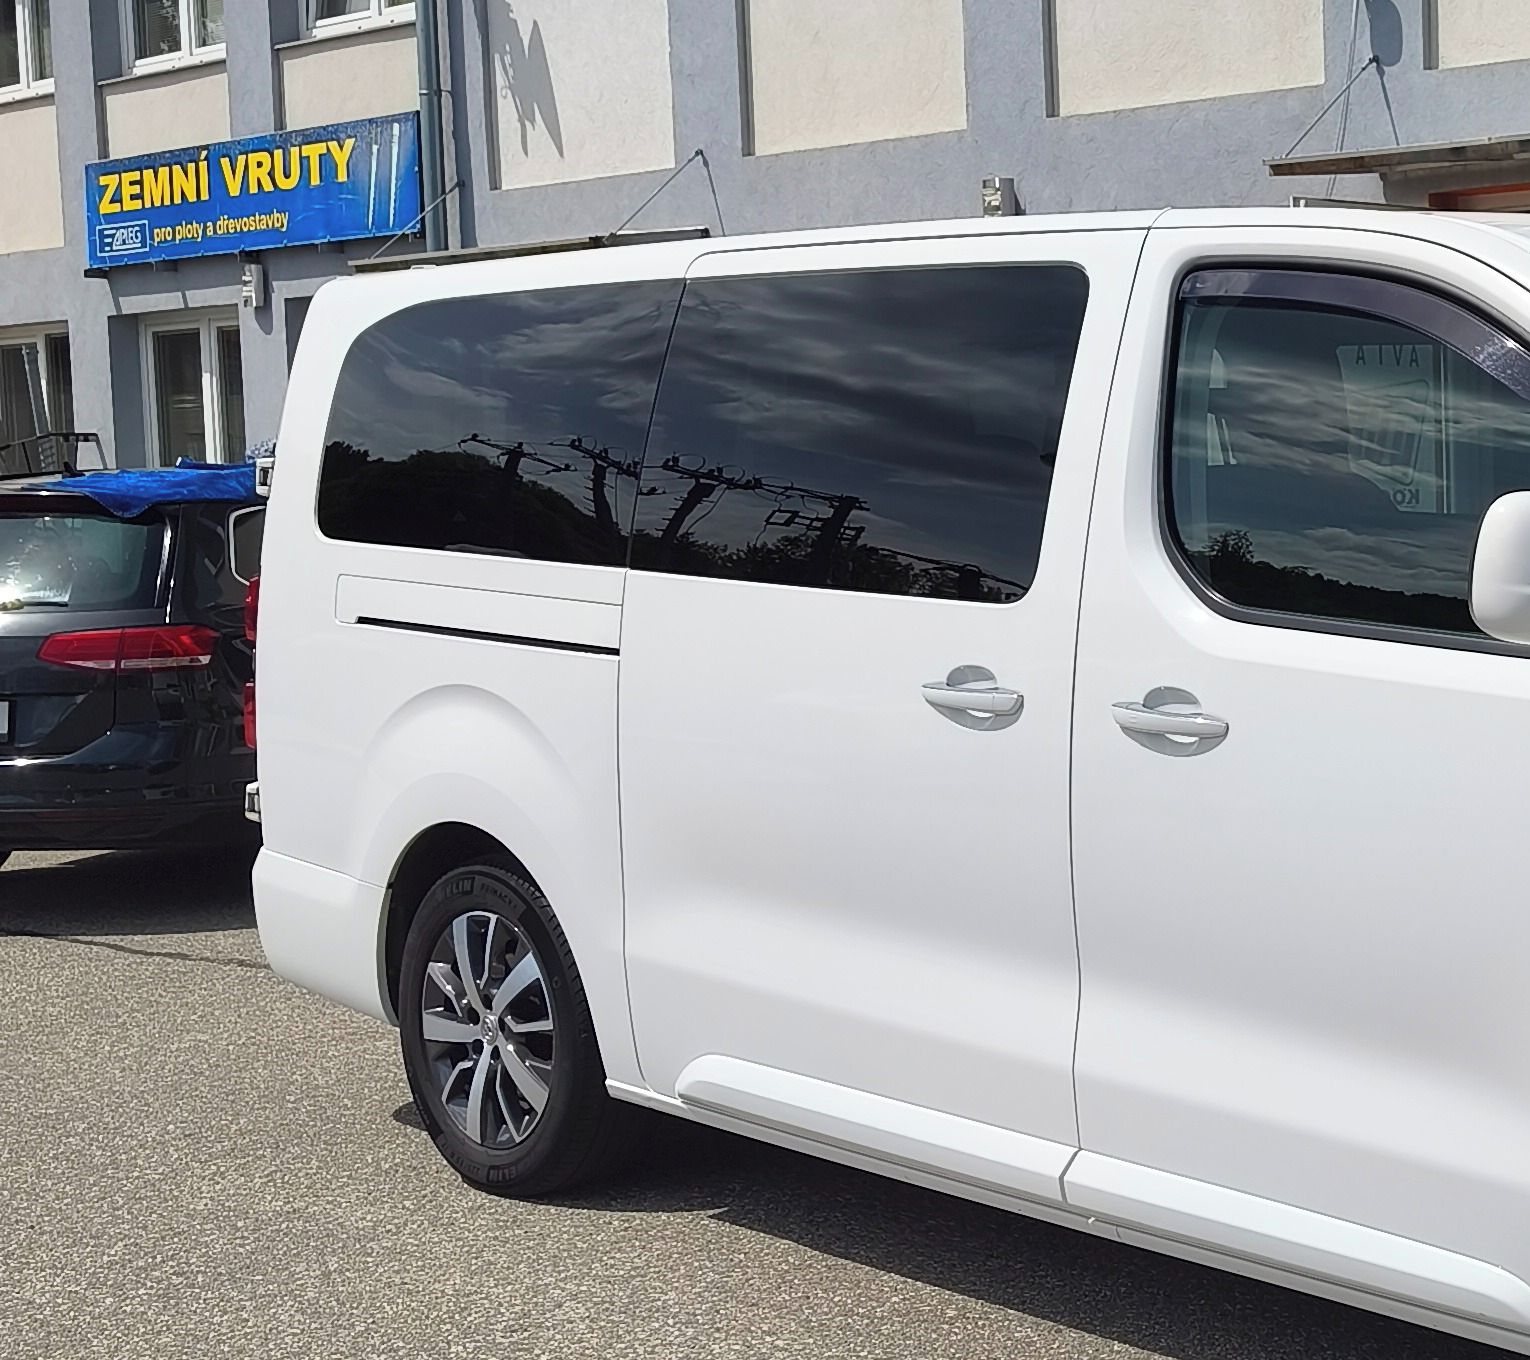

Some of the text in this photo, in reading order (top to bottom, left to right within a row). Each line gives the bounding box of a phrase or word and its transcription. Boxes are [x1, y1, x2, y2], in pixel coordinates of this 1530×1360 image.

[99, 138, 355, 214] ZEMNÍ VRUTY
[153, 208, 289, 246] pro ploty a dřevostavby
